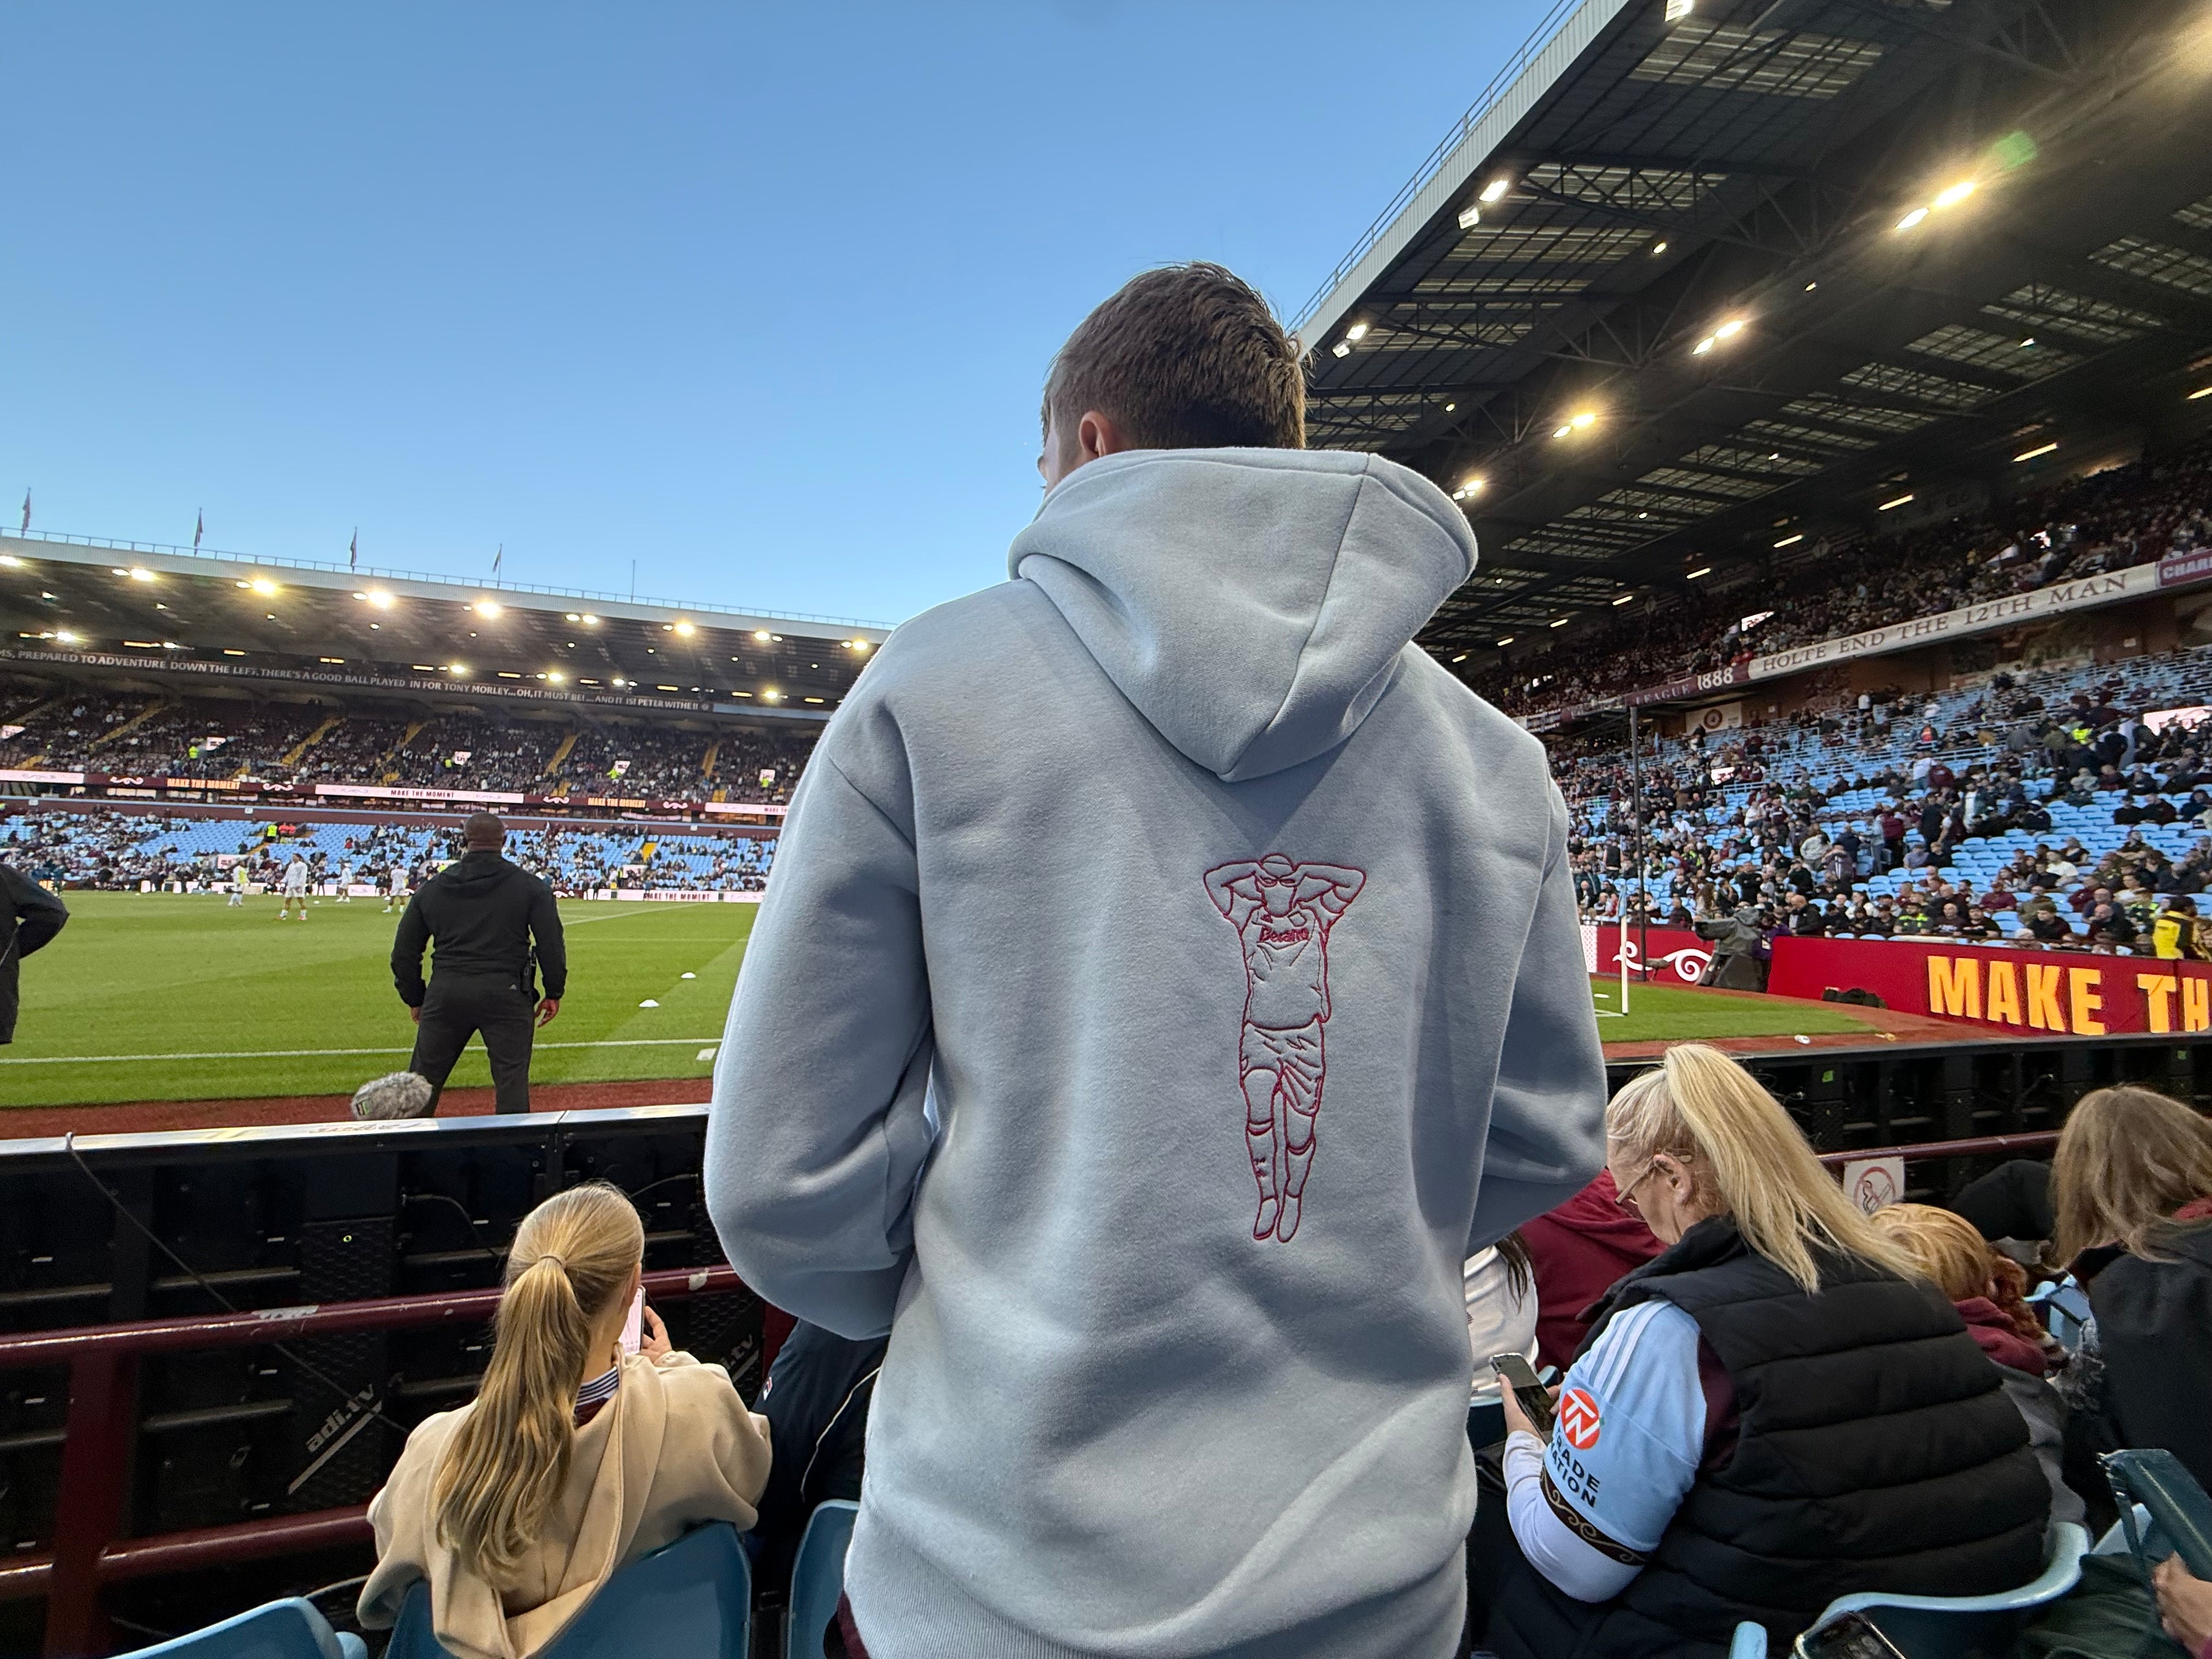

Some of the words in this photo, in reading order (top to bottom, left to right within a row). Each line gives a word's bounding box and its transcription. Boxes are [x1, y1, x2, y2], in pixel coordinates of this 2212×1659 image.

[1763, 645, 1827, 672] HOLTE
[1839, 632, 1885, 654] END
[1897, 615, 1949, 639] THE
[1964, 595, 2034, 625] 12TH
[2048, 573, 2128, 605] MAN
[18, 650, 78, 662] PREPARED
[81, 654, 96, 664] TO
[97, 656, 166, 669] ADVENTURE
[170, 662, 207, 673] DOWN
[209, 664, 229, 673] THE
[302, 671, 310, 680] A
[312, 672, 342, 682] GOOD
[345, 675, 369, 685] BALL
[370, 677, 406, 687] PLAYED
[410, 680, 421, 688] IN
[423, 681, 441, 691] FOR
[444, 682, 470, 692] TONY
[543, 691, 569, 700] MUST
[615, 696, 623, 704] IT
[638, 698, 663, 708] PETER
[1696, 667, 1733, 691] 1888
[167, 778, 190, 787] MAKE
[191, 779, 206, 789] THE
[207, 779, 241, 790] MOMENT
[588, 797, 606, 806] MAKE
[619, 798, 646, 808] MOMENT
[665, 892, 677, 900] THE
[680, 893, 710, 901] MOMENT
[1927, 955, 2106, 1036] MAKE
[305, 1383, 374, 1453] adi.tv
